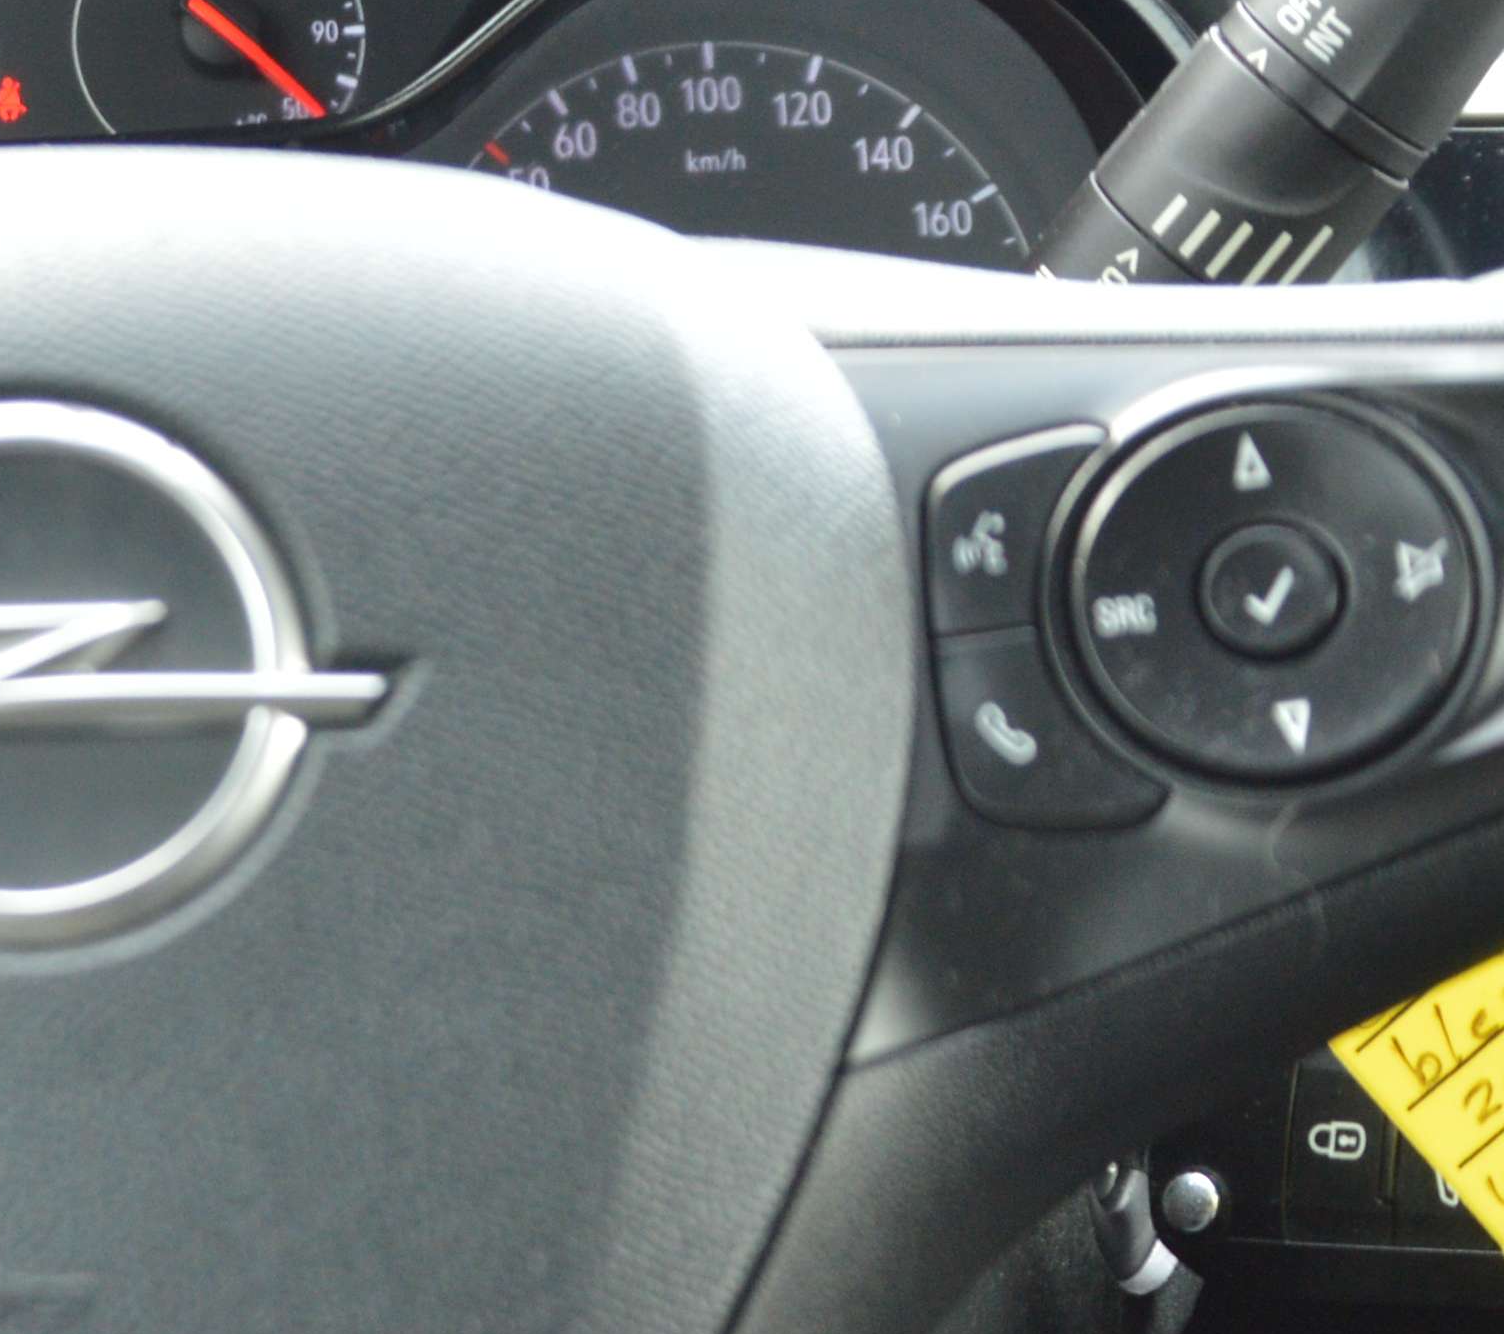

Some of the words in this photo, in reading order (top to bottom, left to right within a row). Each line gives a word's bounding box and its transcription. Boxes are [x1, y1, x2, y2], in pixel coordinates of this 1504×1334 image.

[311, 20, 339, 43] 90
[1303, 6, 1353, 65] INT
[616, 91, 662, 129] 80
[680, 76, 742, 113] 100
[772, 91, 833, 128] 120
[552, 122, 597, 160] 60
[853, 135, 914, 171] 140
[685, 148, 746, 173] km/h
[913, 200, 973, 236] 160
